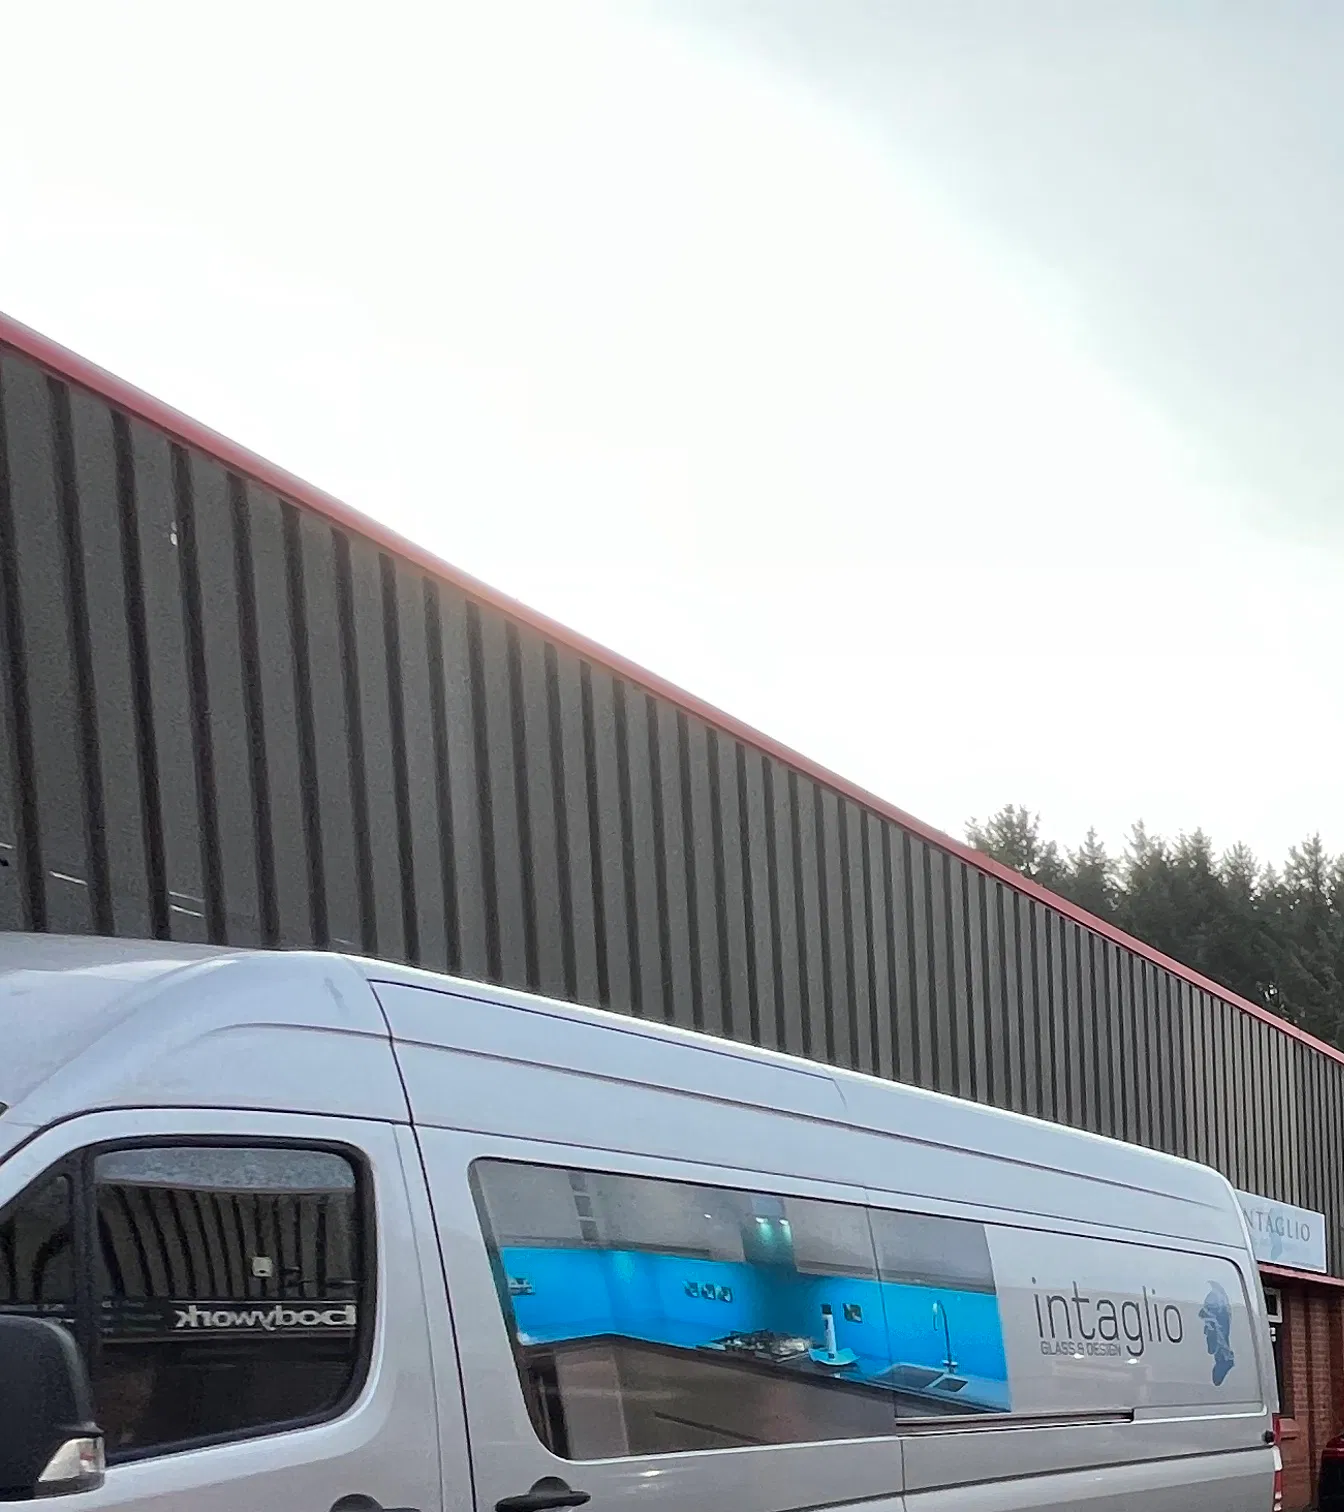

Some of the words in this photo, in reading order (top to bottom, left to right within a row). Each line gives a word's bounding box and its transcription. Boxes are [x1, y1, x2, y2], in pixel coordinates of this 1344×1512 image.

[1243, 1208, 1311, 1242] NTAGLIO
[1031, 1276, 1184, 1357] intaglio
[1040, 1340, 1077, 1356] GLASS
[1085, 1342, 1122, 1357] DESIGN
